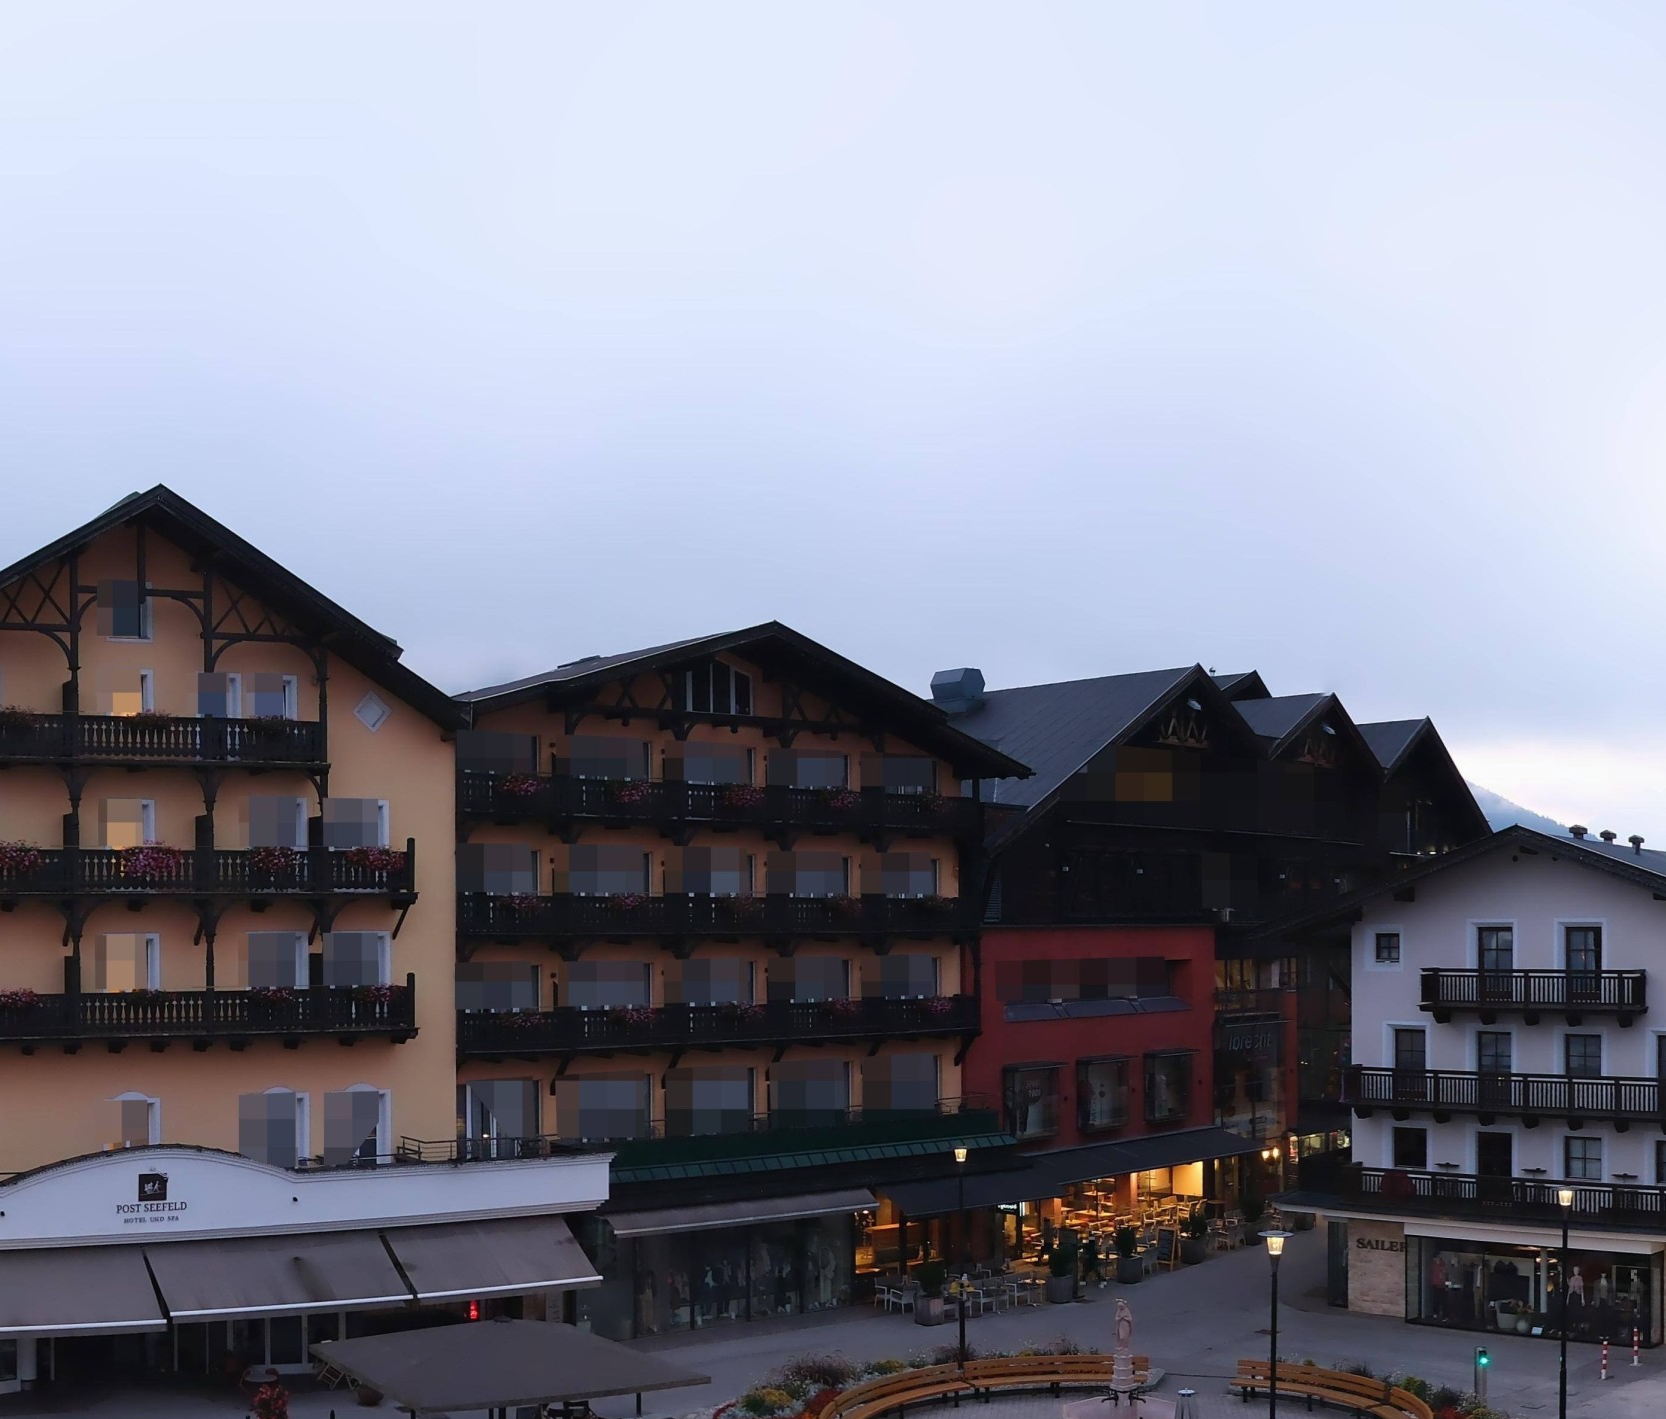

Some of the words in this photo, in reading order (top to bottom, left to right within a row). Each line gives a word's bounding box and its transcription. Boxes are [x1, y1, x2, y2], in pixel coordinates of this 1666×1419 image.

[116, 1203, 142, 1214] POST
[143, 1201, 188, 1213] SEEFELD
[124, 1216, 147, 1224] HOTEL
